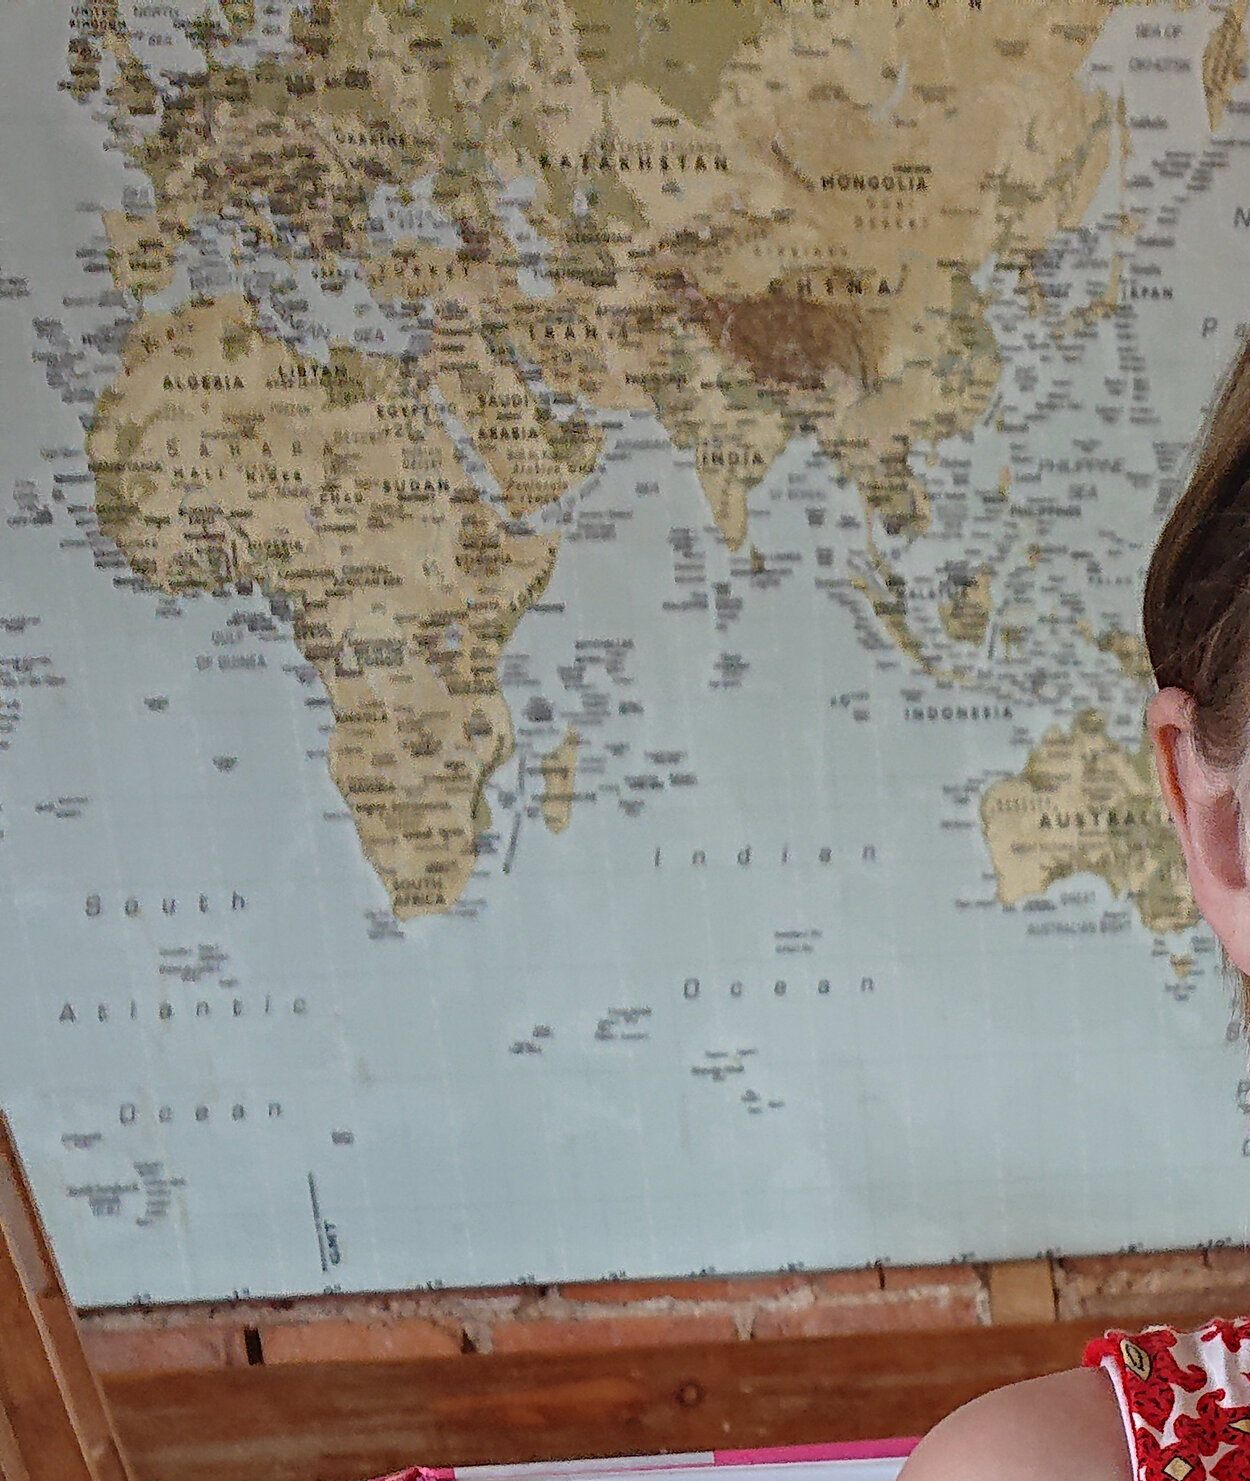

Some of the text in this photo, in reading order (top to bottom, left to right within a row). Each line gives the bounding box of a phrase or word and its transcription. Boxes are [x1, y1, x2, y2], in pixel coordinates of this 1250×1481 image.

[820, 174, 929, 192] MONGOLIA
[702, 450, 766, 467] INDIA
[903, 705, 1014, 721] INDONESIA
[654, 844, 877, 868] Indian
[85, 889, 246, 917] South
[683, 976, 875, 1000] Ocean
[58, 991, 307, 1024] Atlantic
[119, 1101, 283, 1127] Ocean
